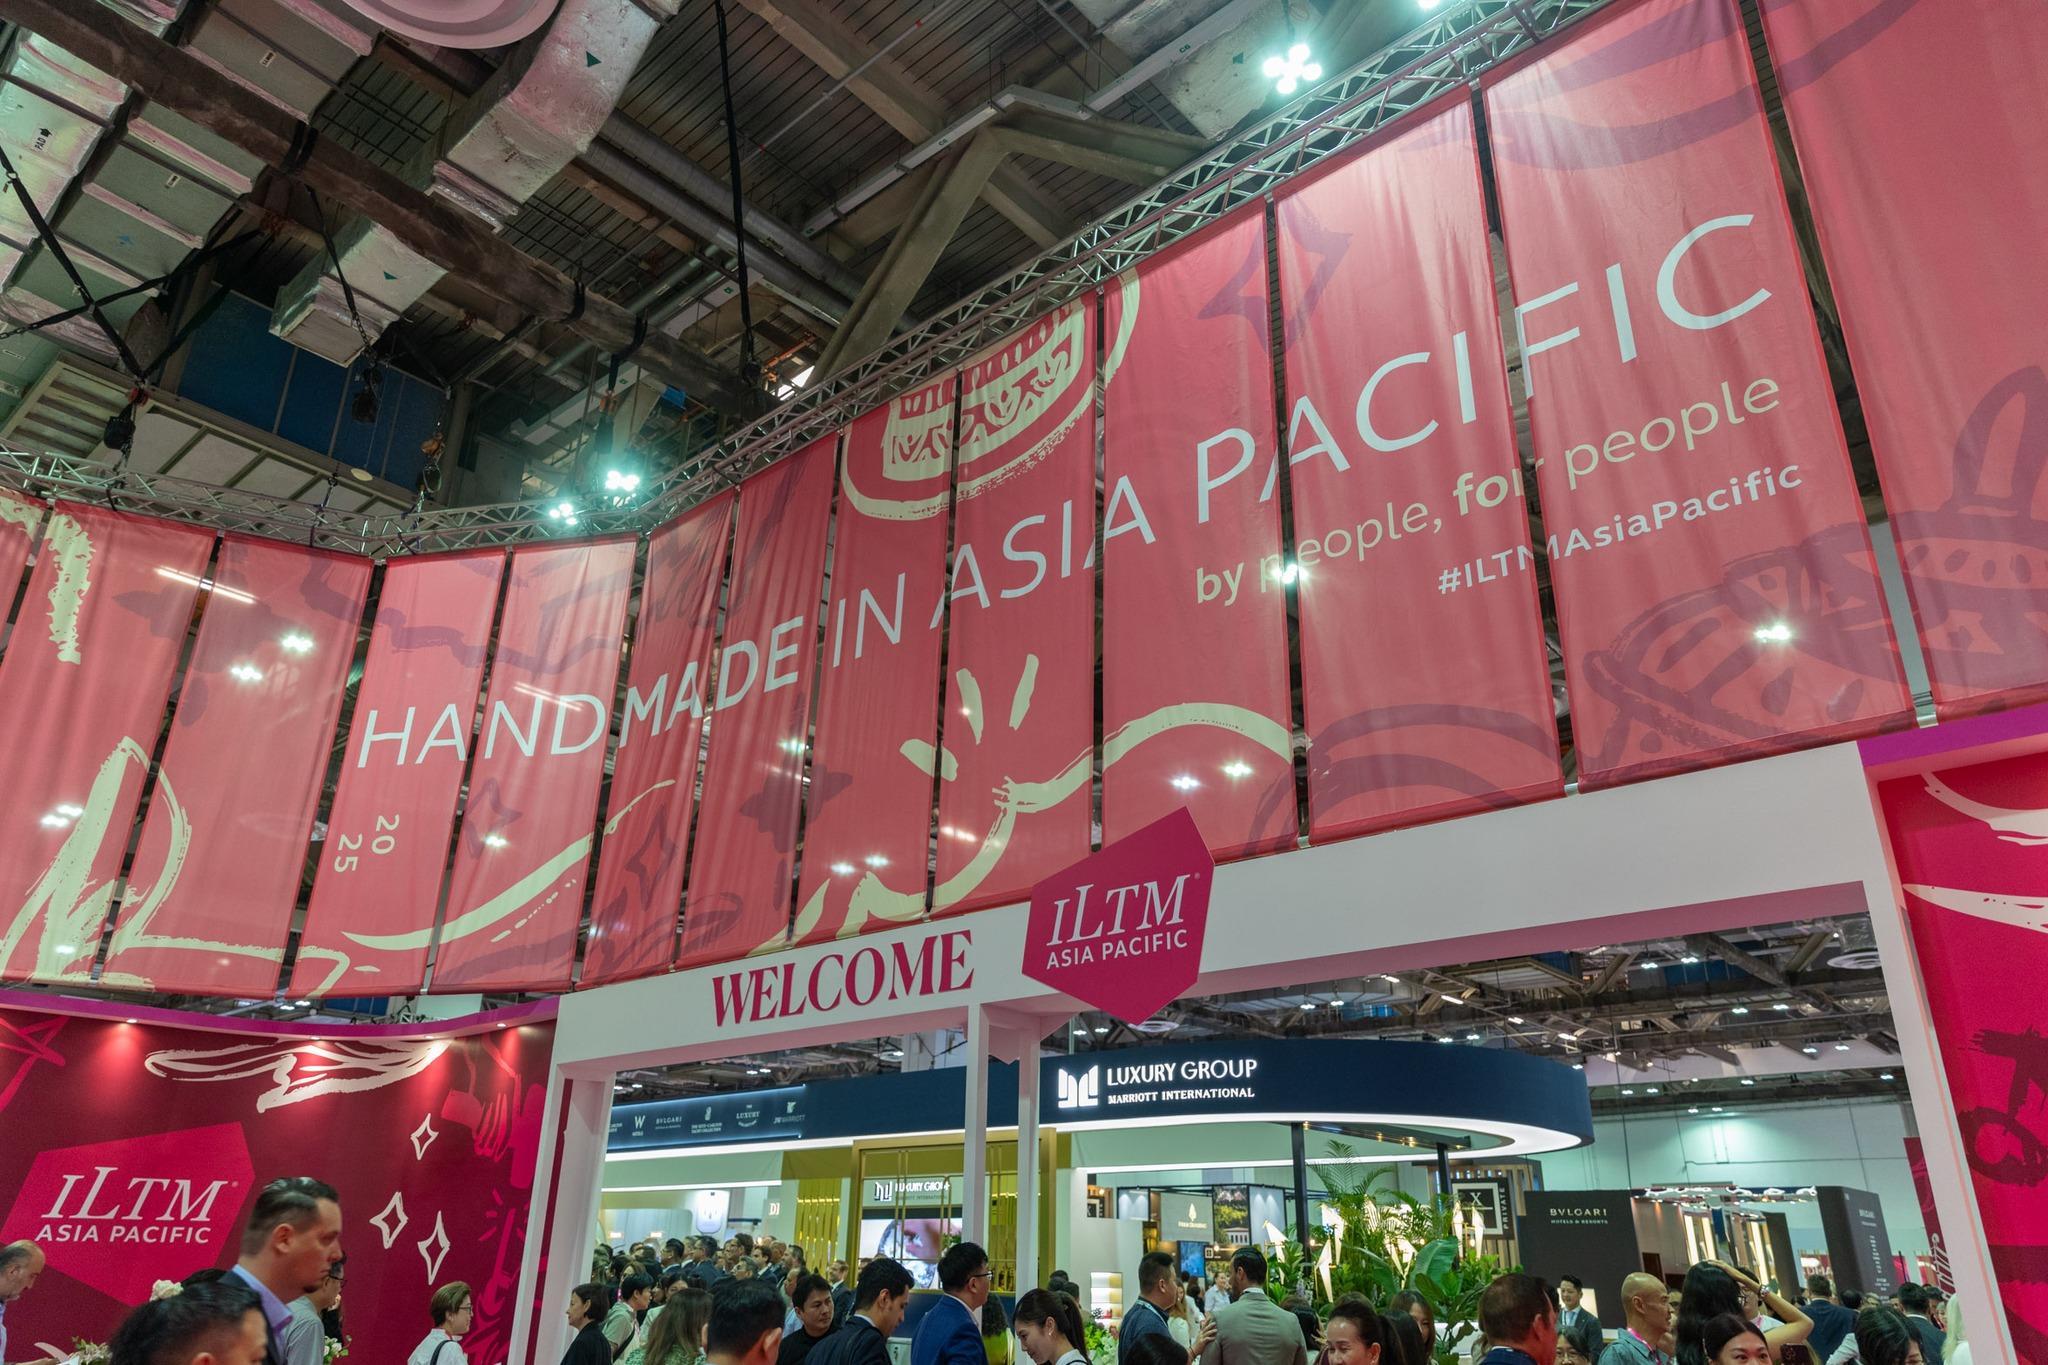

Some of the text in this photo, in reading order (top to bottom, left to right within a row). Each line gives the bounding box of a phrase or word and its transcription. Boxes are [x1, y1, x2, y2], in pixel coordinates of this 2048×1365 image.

[833, 573, 906, 667] IN
[930, 475, 1156, 630] ASIA
[1196, 214, 1772, 523] PACIFIC
[1196, 560, 1244, 607] by
[1564, 377, 1781, 490] people
[1438, 464, 1803, 594] #ILTMAsiaPacific
[334, 833, 363, 873] 25
[371, 814, 400, 855] 20
[1046, 929, 1188, 970] ASIA PACIFIC
[712, 929, 975, 1027] WELCOME
[1107, 1059, 1258, 1086] LUXURY GROUP
[1108, 1087, 1255, 1105] MARRIOTT INTERNATIONAL
[634, 1115, 646, 1129] W
[1470, 1192, 1482, 1206] X
[1500, 1187, 1509, 1230] PRIVATE
[1550, 1208, 1608, 1217] BVLGARI
[35, 1224, 212, 1245] ASIA PACIFIC
